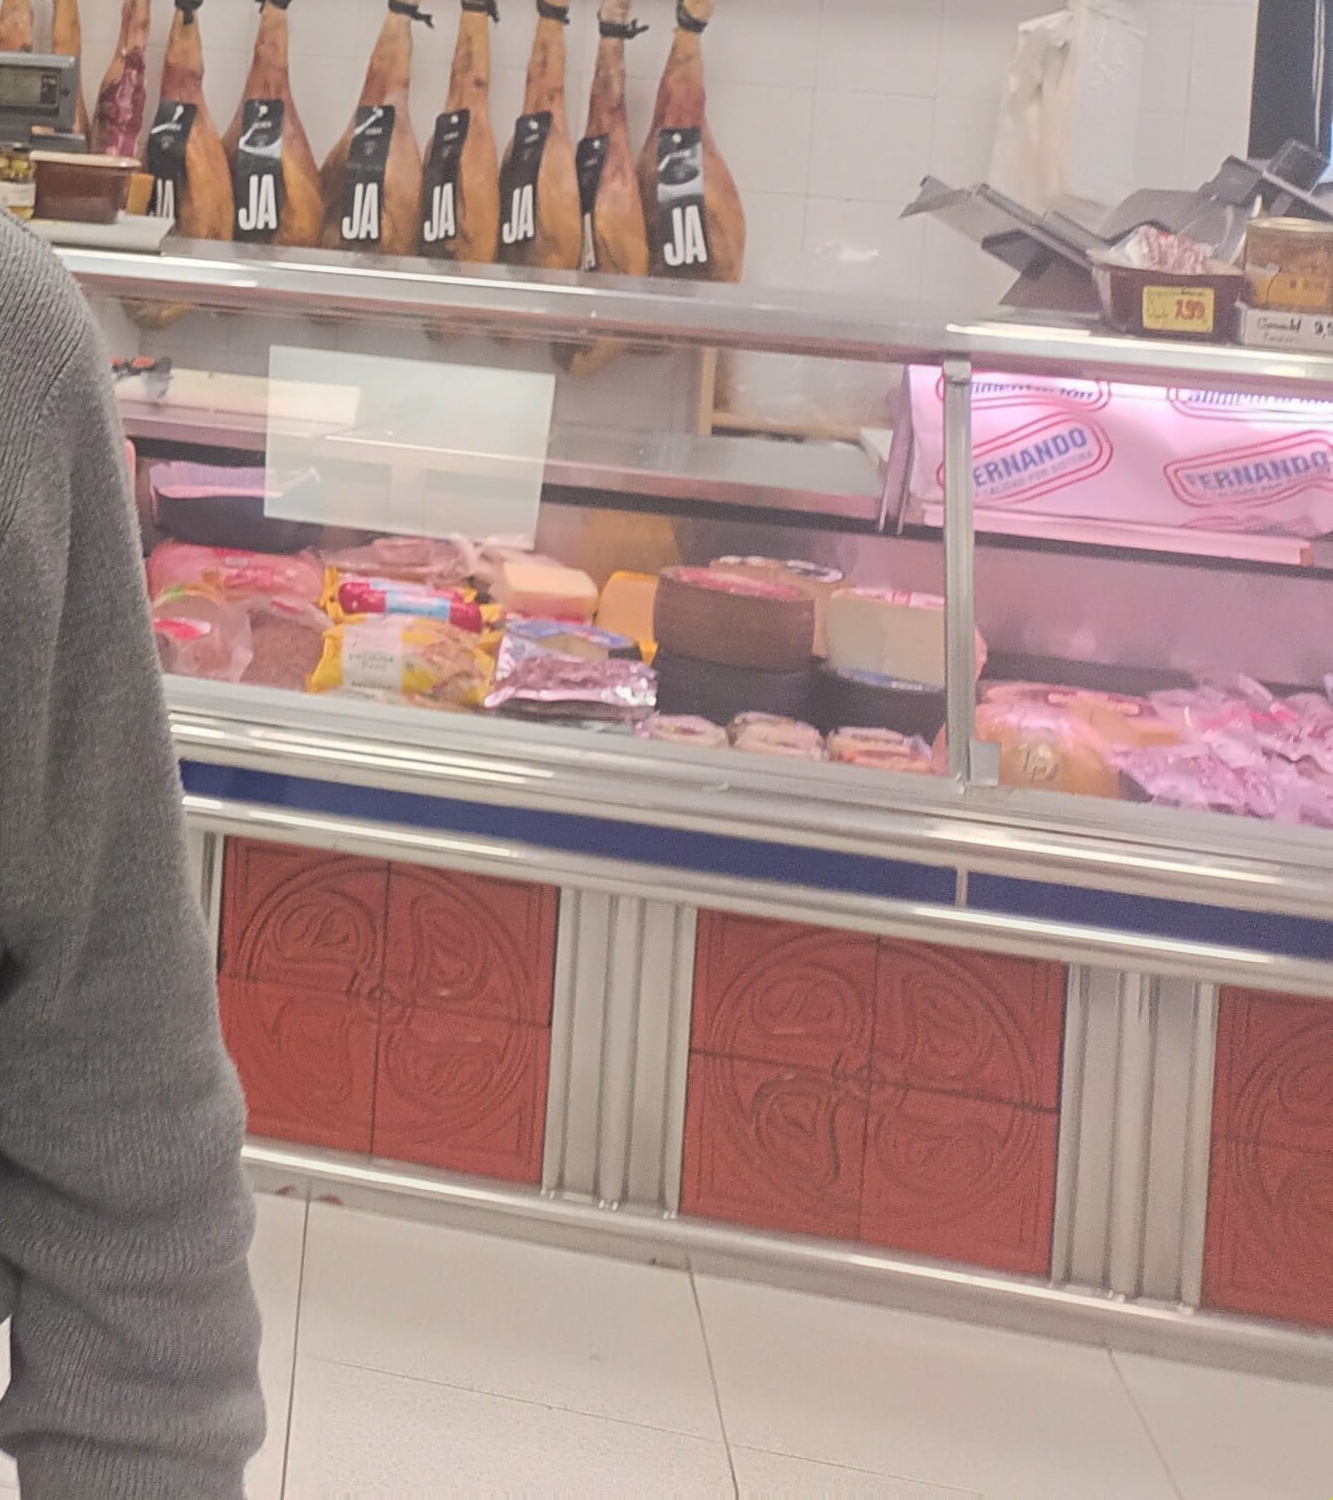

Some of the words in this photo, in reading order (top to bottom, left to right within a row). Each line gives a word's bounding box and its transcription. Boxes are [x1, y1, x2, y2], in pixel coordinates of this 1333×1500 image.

[237, 173, 278, 231] JA
[341, 181, 380, 240] JA
[423, 182, 456, 243] JA
[502, 183, 535, 245] JA
[663, 204, 708, 267] JA
[972, 426, 1089, 489] ERNANDO
